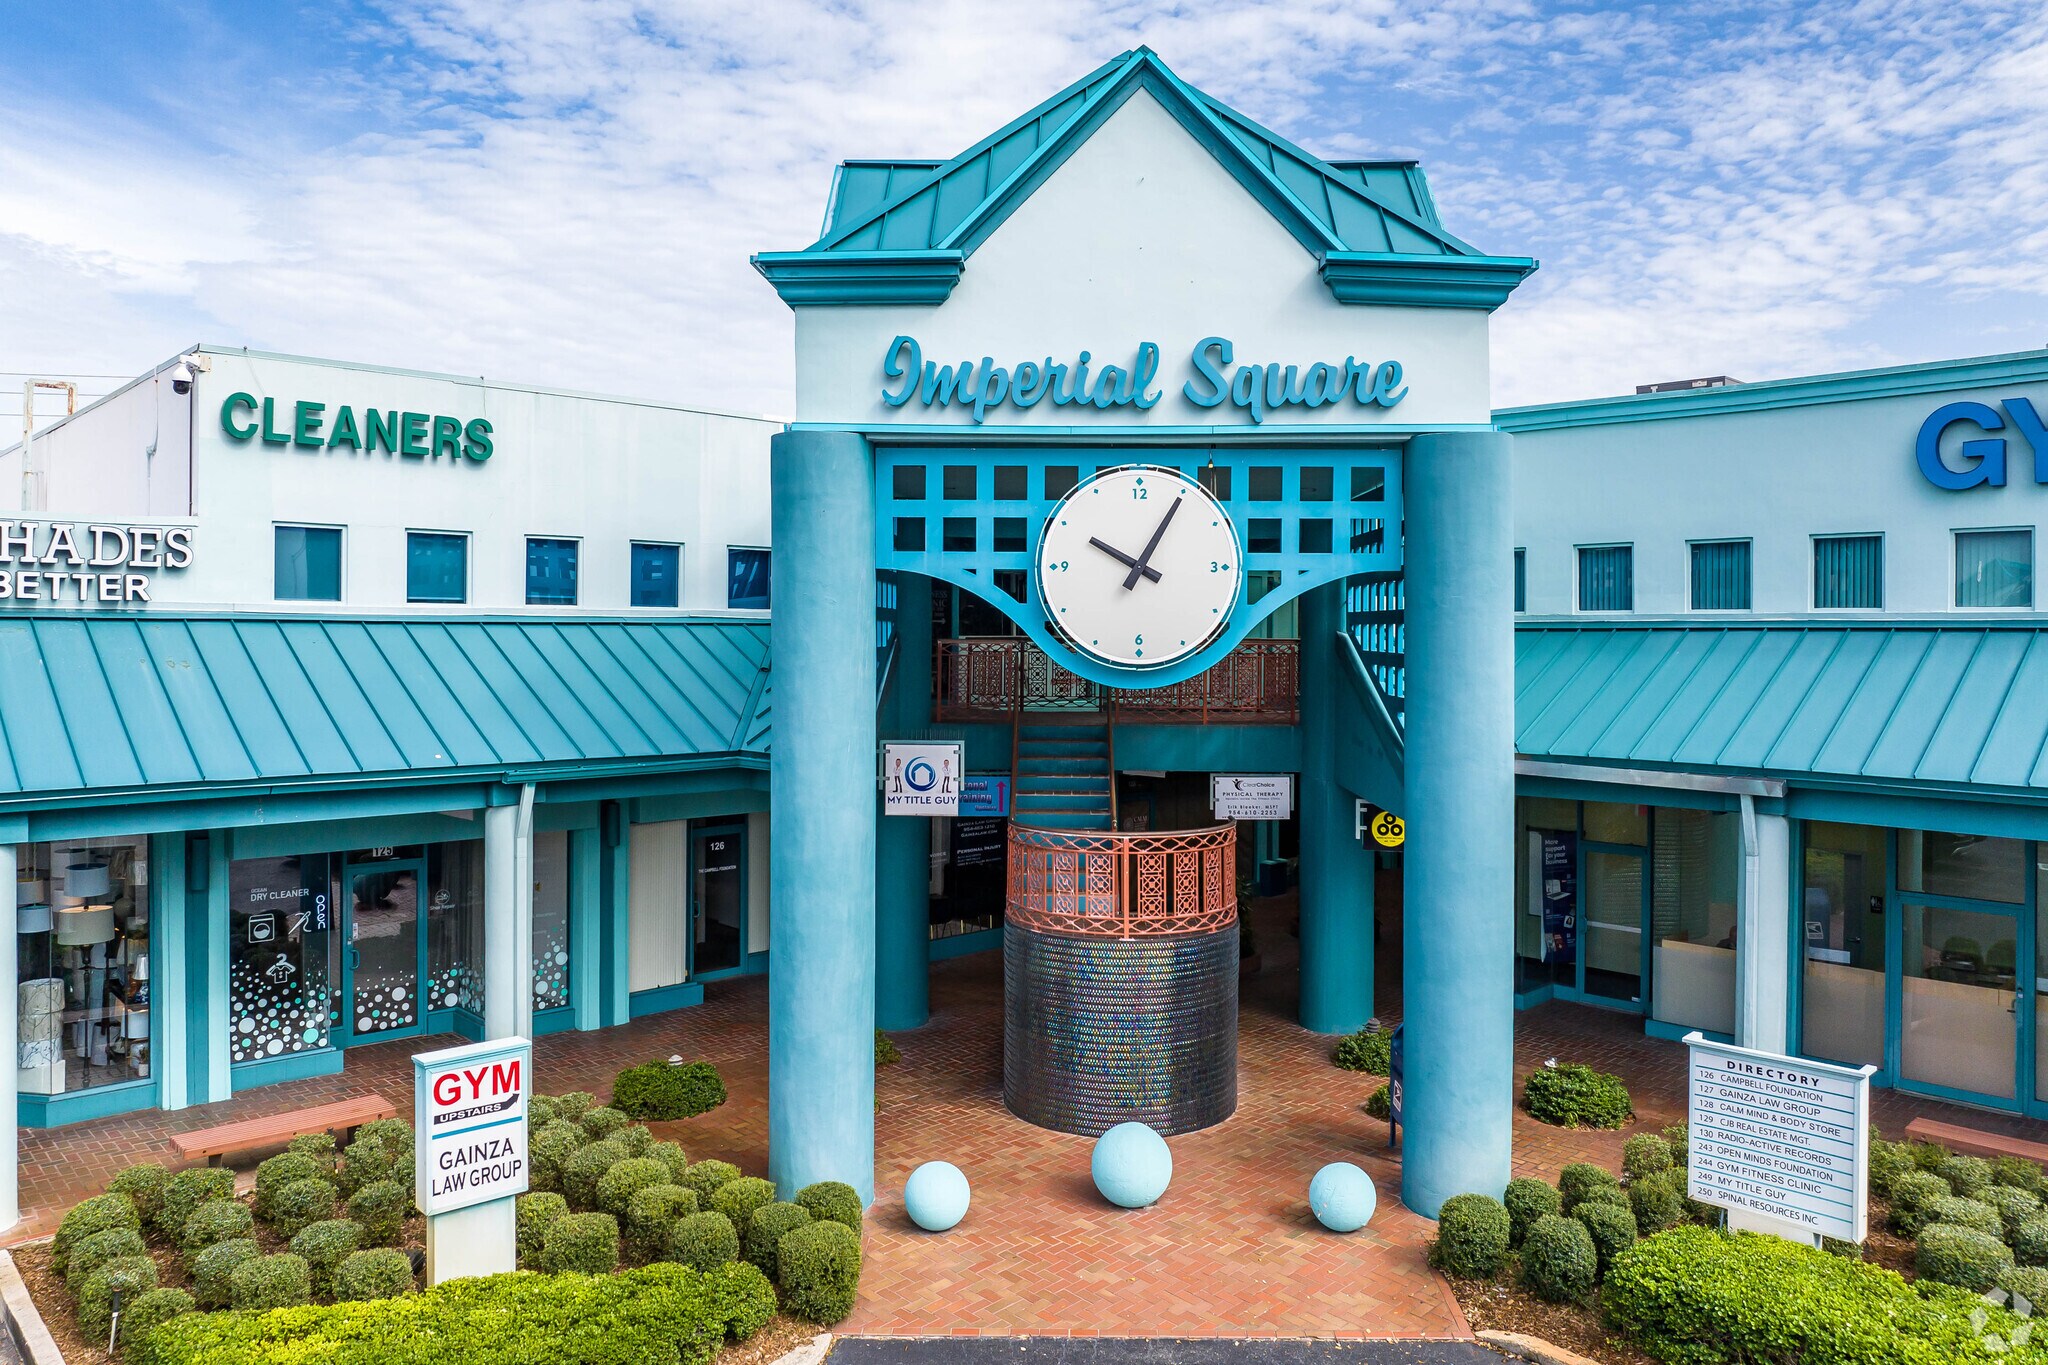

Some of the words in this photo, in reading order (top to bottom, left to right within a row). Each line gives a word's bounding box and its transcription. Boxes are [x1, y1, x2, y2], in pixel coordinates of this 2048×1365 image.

[882, 335, 1163, 424] Imperial
[1183, 336, 1410, 424] Square
[221, 391, 494, 462] CLEANERS
[1131, 488, 1148, 500] 12
[0, 520, 194, 569] HADES
[1060, 561, 1069, 573] 9
[1210, 561, 1219, 573] 3
[0, 570, 152, 602] BETTER
[1134, 634, 1143, 646] 6
[887, 796, 904, 804] MY
[904, 796, 932, 804] TITLE
[934, 796, 957, 805] GUY
[373, 847, 393, 857] 125
[710, 841, 724, 850] 126
[250, 893, 268, 902] DRY
[269, 888, 310, 900] CLEANER
[433, 1060, 520, 1107] GYM
[1699, 1070, 1714, 1079] 126
[1720, 1074, 1764, 1090] CAMPBELL
[1765, 1084, 1823, 1102] FOUNDATION
[1726, 1060, 1820, 1087] DIRECTORY
[439, 1103, 502, 1123] UPSTAIRS
[1699, 1085, 1714, 1094] 127
[1719, 1088, 1756, 1103] GAINZA
[1759, 1096, 1780, 1108] LAW
[1783, 1102, 1821, 1117] GROUP
[1699, 1099, 1714, 1108] 128
[1719, 1103, 1744, 1115] CALM
[1746, 1109, 1768, 1120] MIND
[1771, 1114, 1777, 1122] &
[1780, 1116, 1806, 1128] BODY
[1809, 1123, 1841, 1137] STORE
[1699, 1114, 1714, 1123] 129
[1719, 1118, 1735, 1129] CJB
[1736, 1122, 1757, 1133] REAL
[1758, 1127, 1788, 1140] ESTATE
[1789, 1134, 1811, 1146] MGT.
[439, 1137, 514, 1171] GAINZA
[1698, 1143, 1713, 1152] 243
[1717, 1146, 1742, 1159] OPEN
[1743, 1152, 1772, 1166] MINDS
[1774, 1160, 1833, 1182] FOUNDATION
[1699, 1129, 1714, 1138] 130
[1717, 1131, 1782, 1154] RADIO-ACTIVE
[1784, 1147, 1832, 1166] RECORDS
[432, 1171, 466, 1197] LAW
[469, 1159, 522, 1188] GROUP
[1697, 1172, 1713, 1181] 249
[1717, 1176, 1733, 1186] MY
[1735, 1180, 1762, 1195] TITLE
[1765, 1188, 1787, 1201] GUY
[1698, 1157, 1713, 1167] 244
[1716, 1161, 1739, 1174] GYM
[1742, 1167, 1784, 1185] FITNESS
[1787, 1178, 1822, 1194] CLINIC
[1697, 1187, 1713, 1197] 250
[1718, 1190, 1748, 1206] SPINAL
[1749, 1199, 1800, 1221] RESOURCES
[1801, 1214, 1819, 1225] INC
